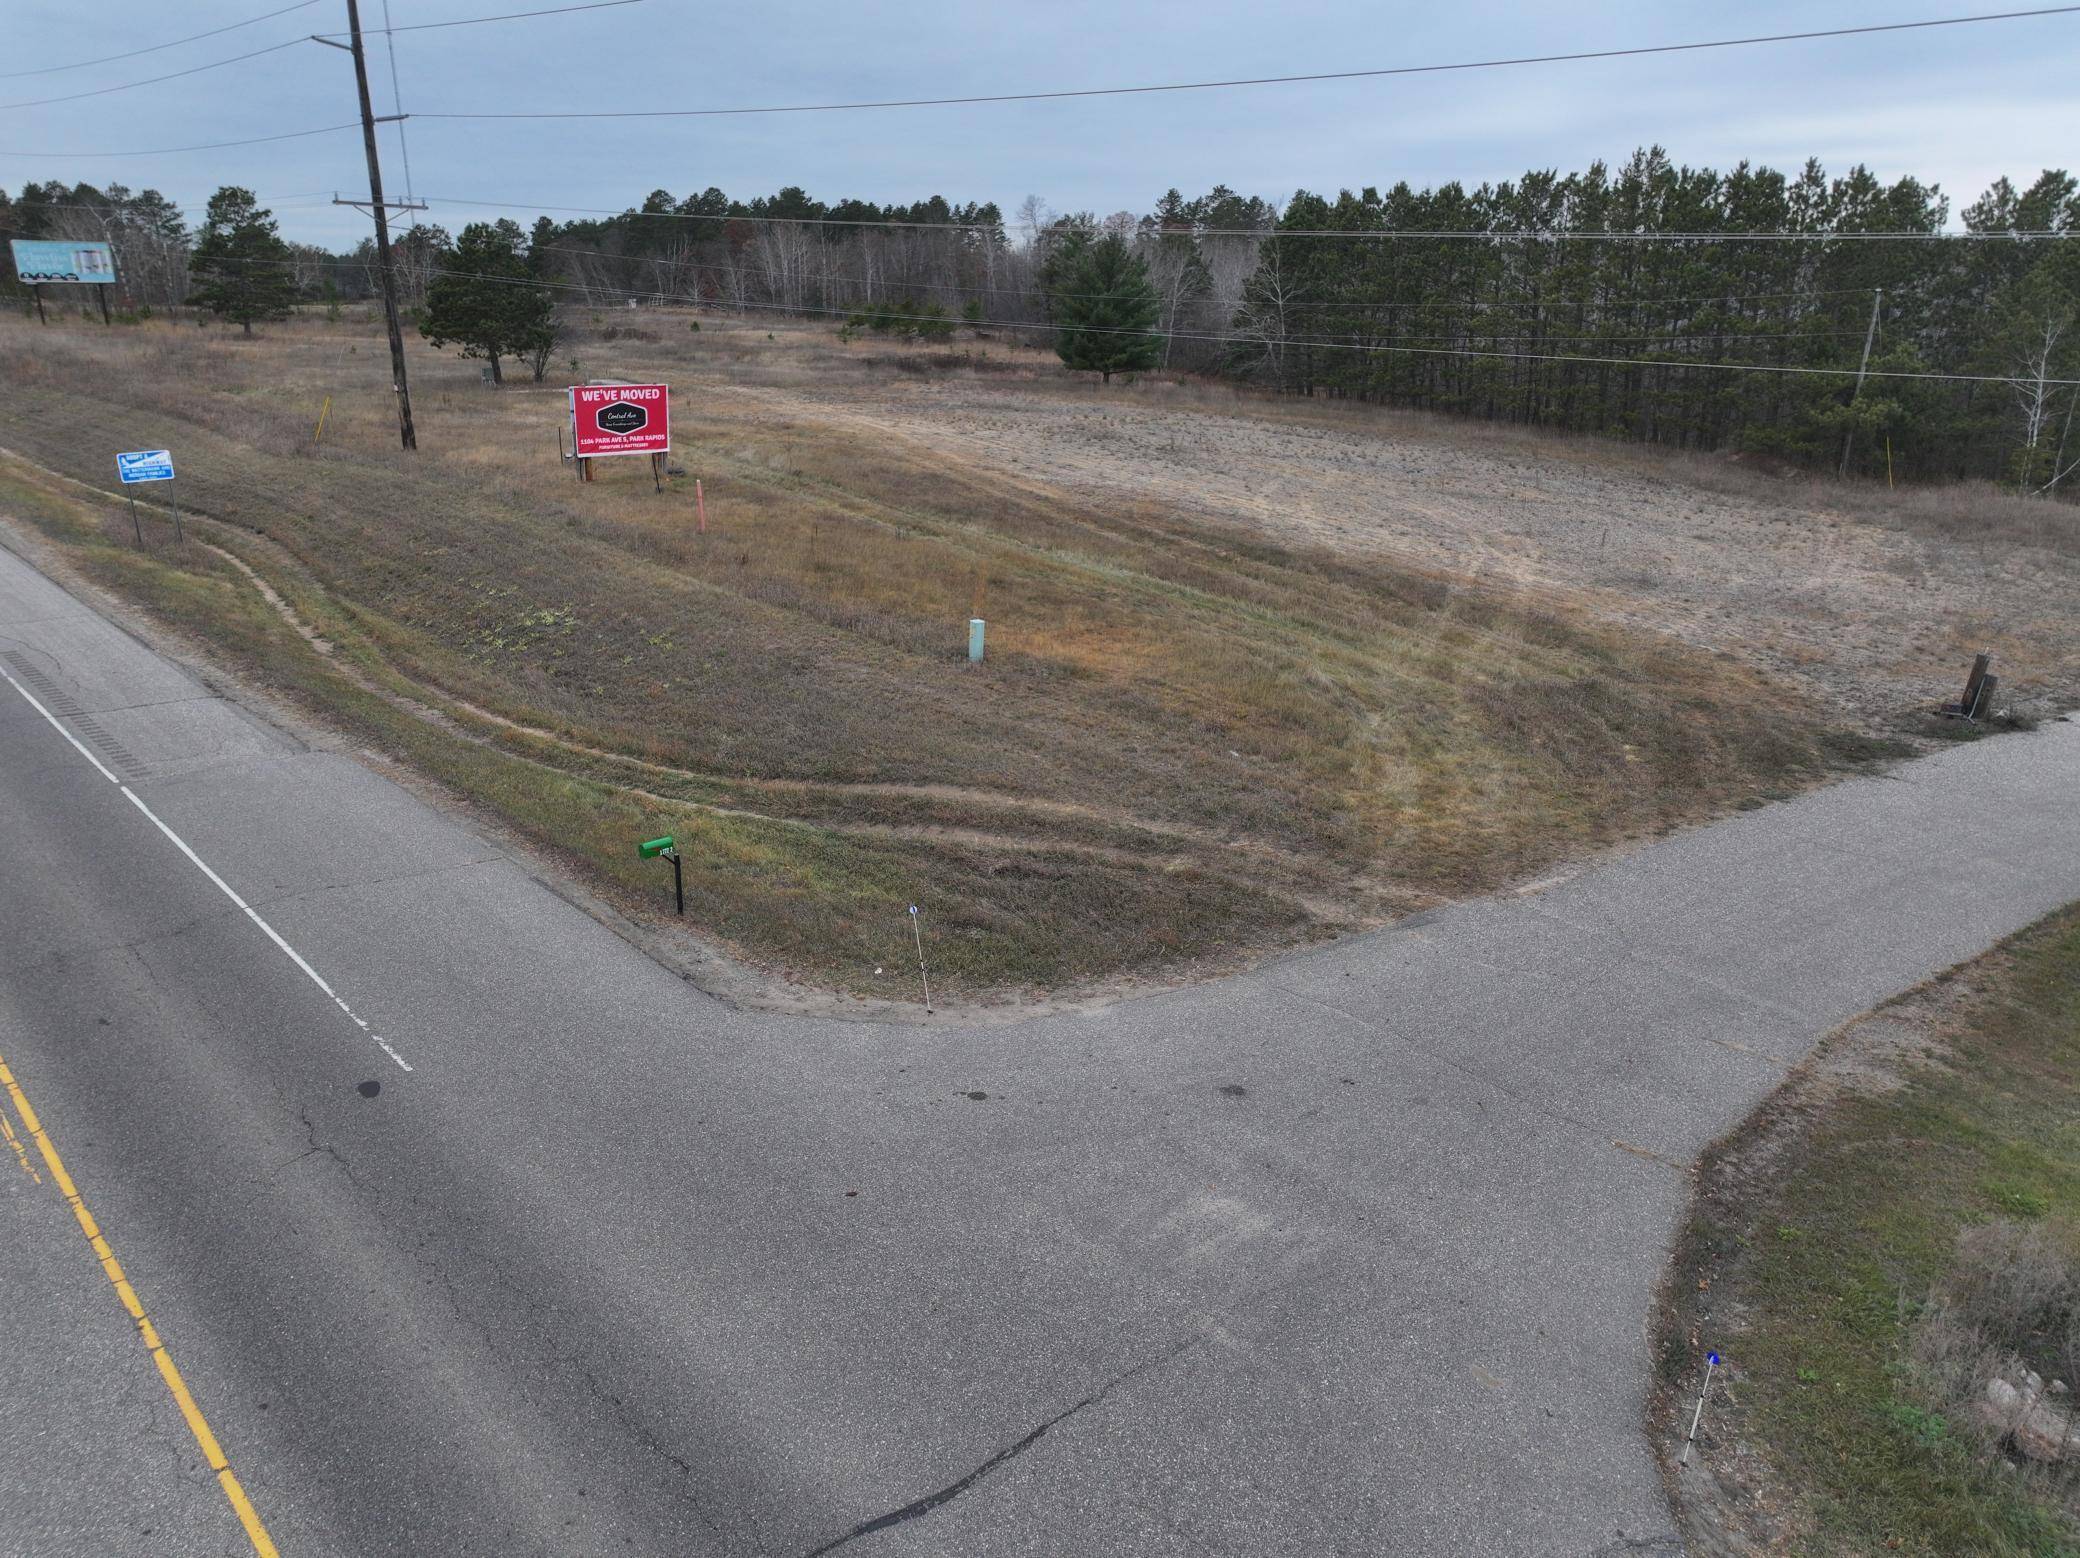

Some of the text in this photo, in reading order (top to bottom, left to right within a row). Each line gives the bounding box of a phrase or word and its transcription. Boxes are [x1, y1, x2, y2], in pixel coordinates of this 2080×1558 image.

[582, 389, 660, 401] WE'VE MOVED
[608, 412, 627, 420] Central
